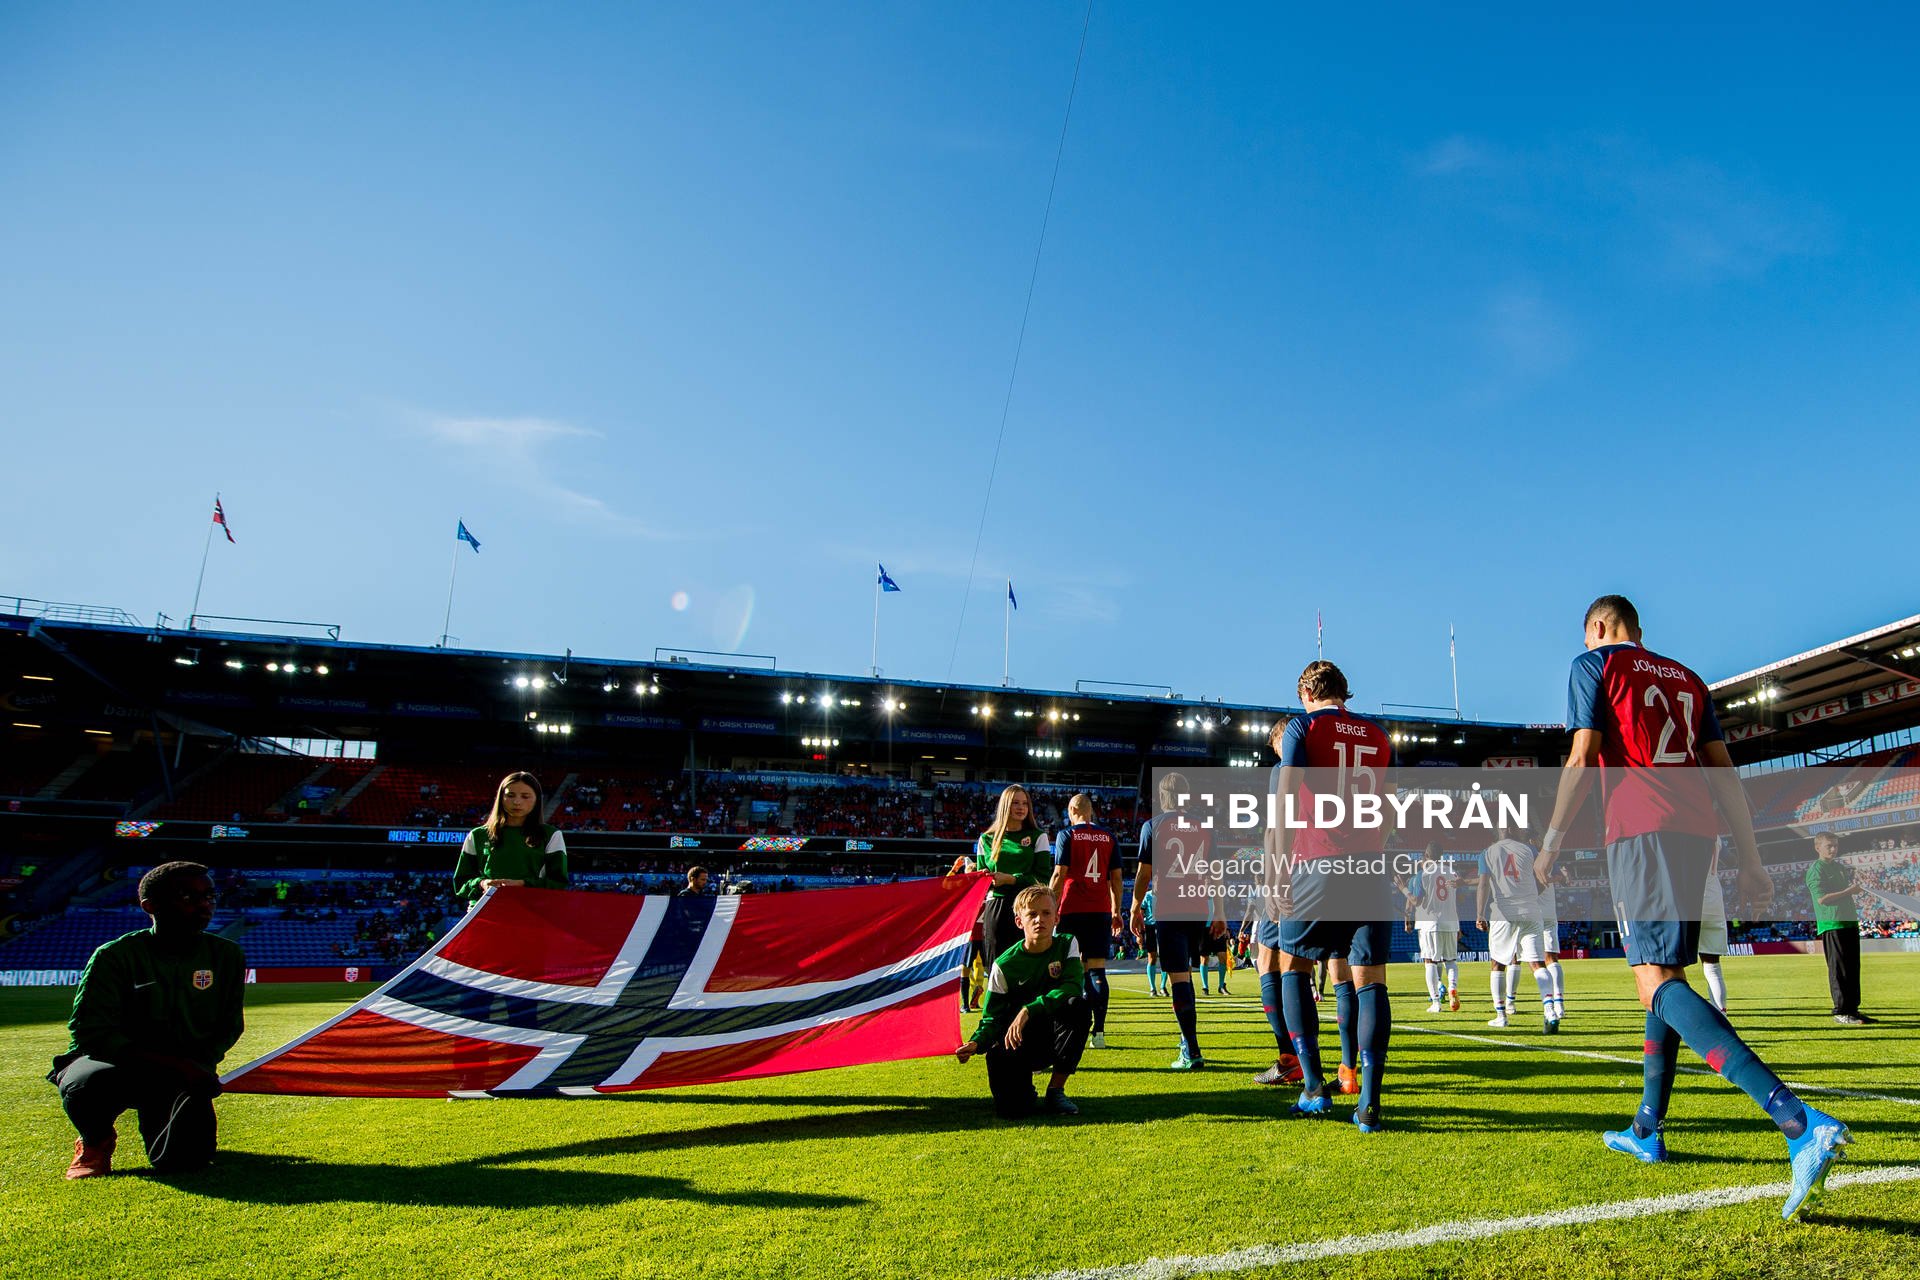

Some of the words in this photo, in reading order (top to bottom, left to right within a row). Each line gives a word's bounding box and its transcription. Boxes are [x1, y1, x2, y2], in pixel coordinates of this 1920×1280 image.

[1632, 660, 1688, 682] JOHNSEN
[648, 717, 681, 726] TIPNG
[1643, 684, 1696, 764] 21
[1795, 702, 1843, 727] VG
[1335, 722, 1368, 737] BERGE
[1333, 741, 1379, 807] 15
[387, 829, 421, 842] NORGE
[426, 831, 468, 843] SLOVENI
[1084, 847, 1102, 883] 4
[1165, 837, 1205, 881] 24
[1503, 853, 1520, 883] 4
[1435, 875, 1449, 902] 8
[1727, 943, 1754, 956] ANAMA
